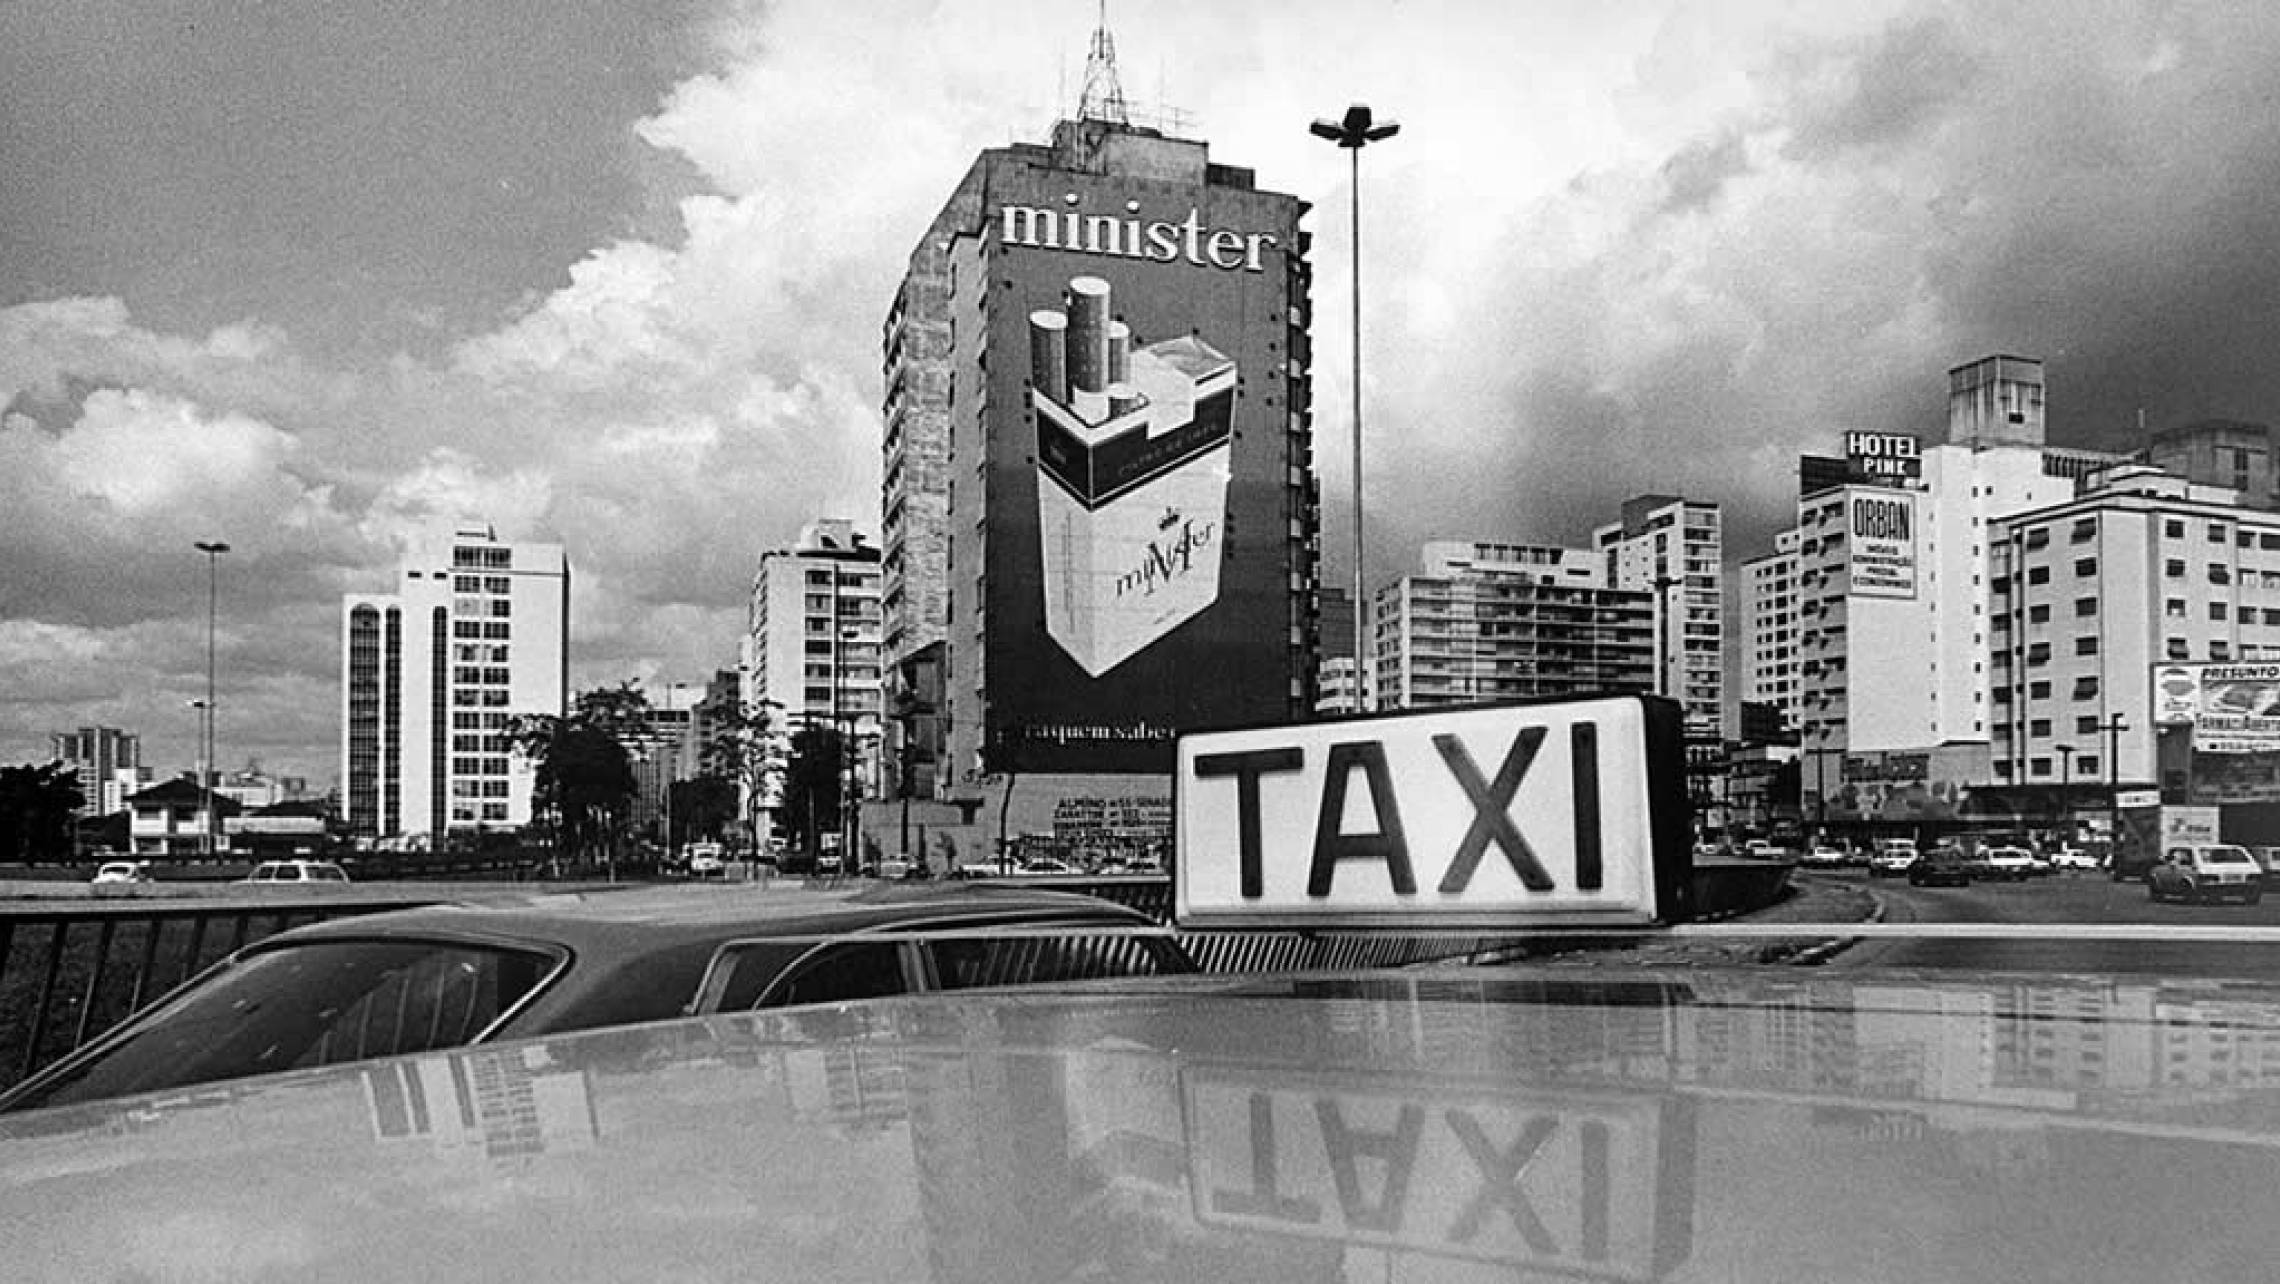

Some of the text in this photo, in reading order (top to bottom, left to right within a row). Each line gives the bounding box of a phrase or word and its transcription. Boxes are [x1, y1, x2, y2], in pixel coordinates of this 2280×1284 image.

[1000, 193, 1278, 271] minister
[1850, 432, 1920, 459] HOTEL
[1854, 498, 1910, 540] ORBAN
[1193, 720, 1602, 899] TAXI
